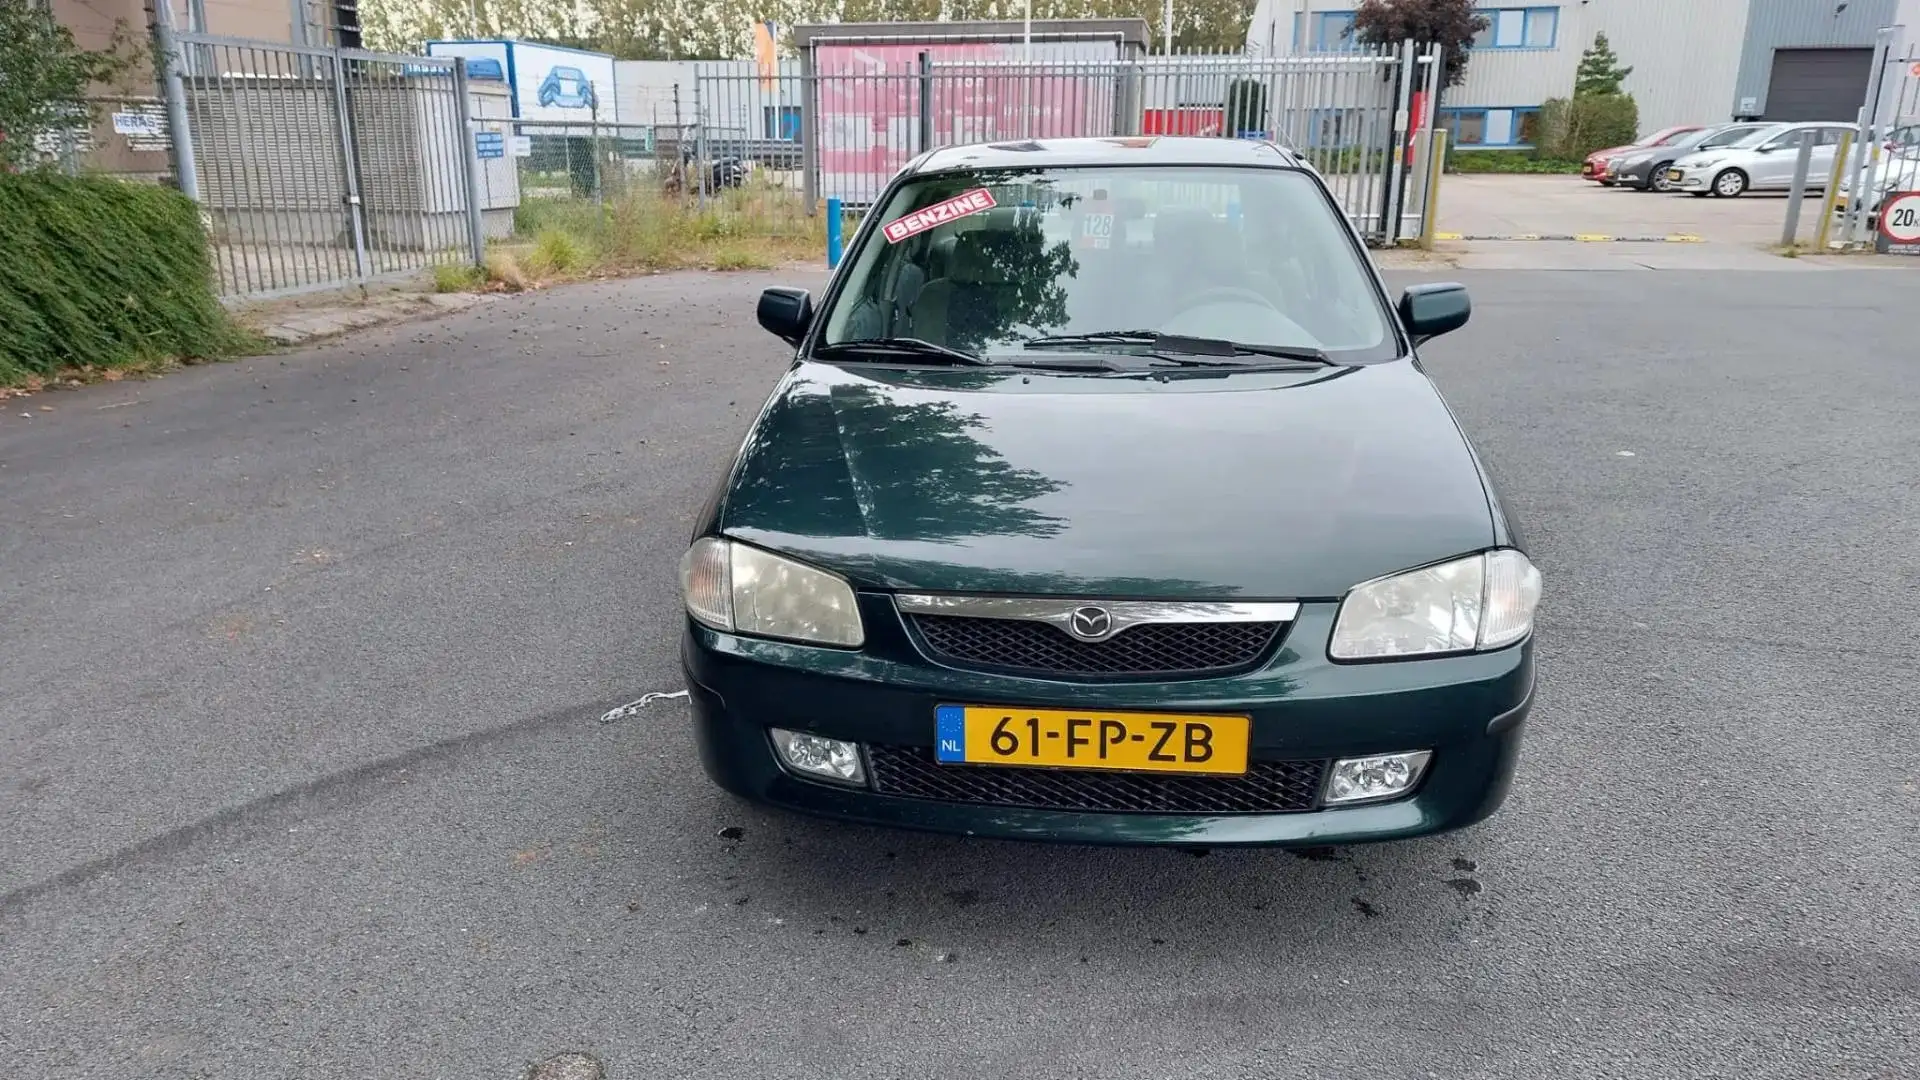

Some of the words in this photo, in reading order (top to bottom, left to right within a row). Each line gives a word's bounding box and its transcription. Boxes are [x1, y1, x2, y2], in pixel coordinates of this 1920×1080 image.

[115, 115, 156, 128] HERAS
[890, 191, 989, 240] BENZINE
[1086, 214, 1112, 237] 128
[1892, 208, 1914, 227] 20
[941, 739, 961, 753] NL
[989, 716, 1214, 764] 61-FP-ZB
